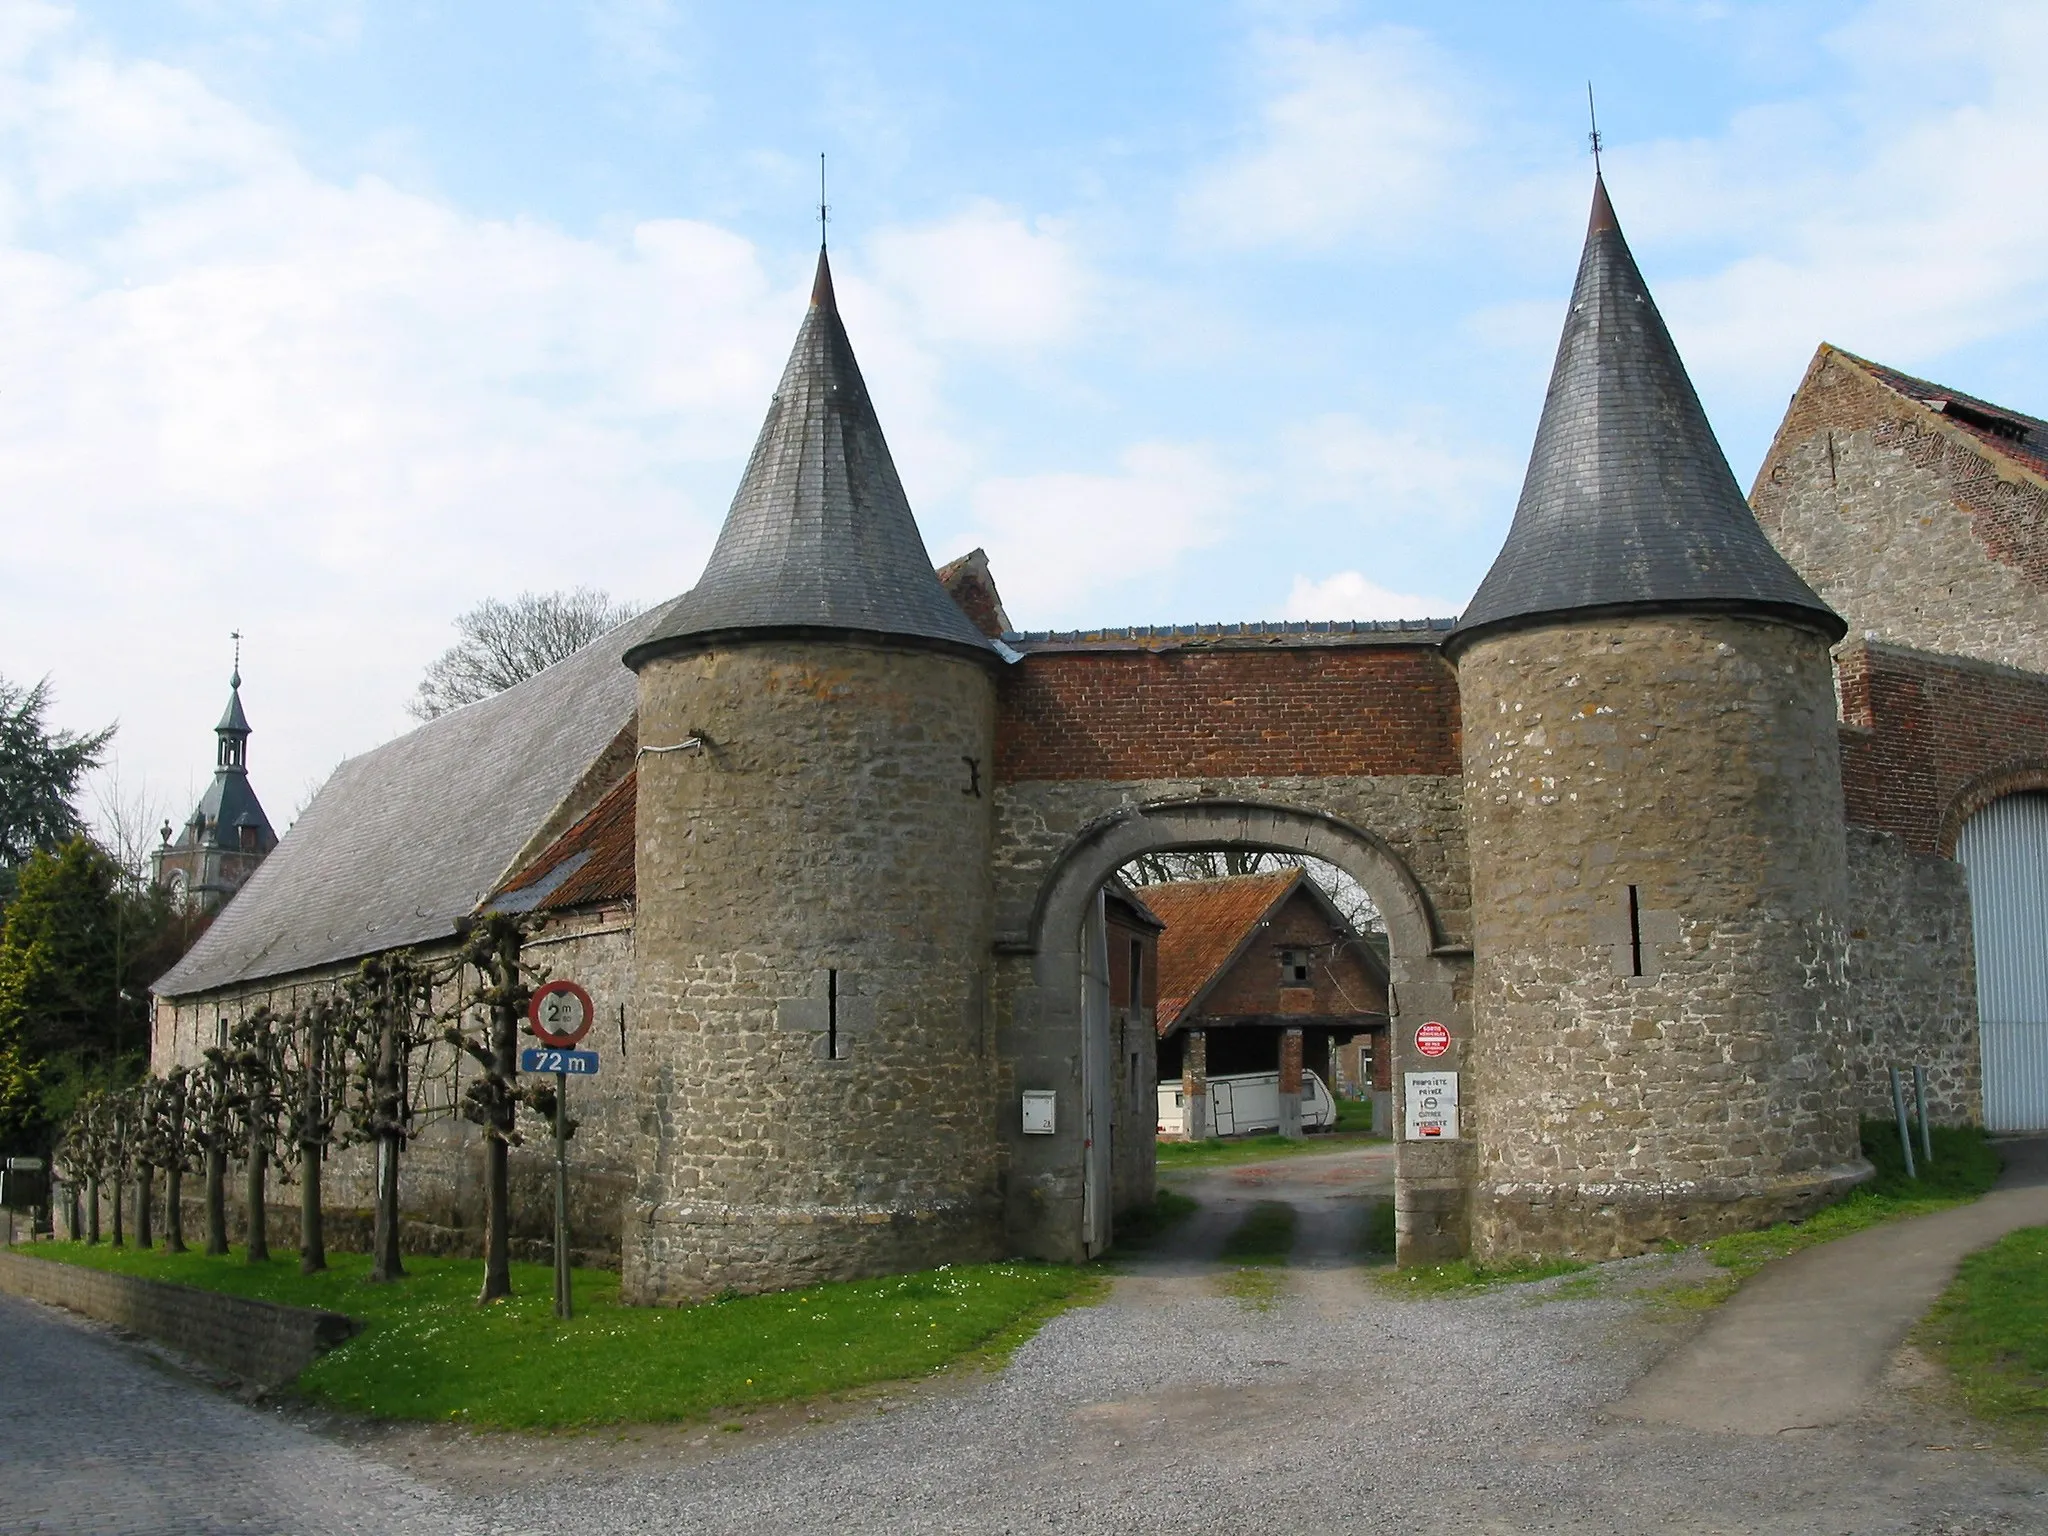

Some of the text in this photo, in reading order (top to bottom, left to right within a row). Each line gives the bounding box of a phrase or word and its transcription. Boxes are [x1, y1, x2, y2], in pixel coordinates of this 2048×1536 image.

[548, 1004, 571, 1022] 2 m
[535, 1052, 585, 1071] 72 m
